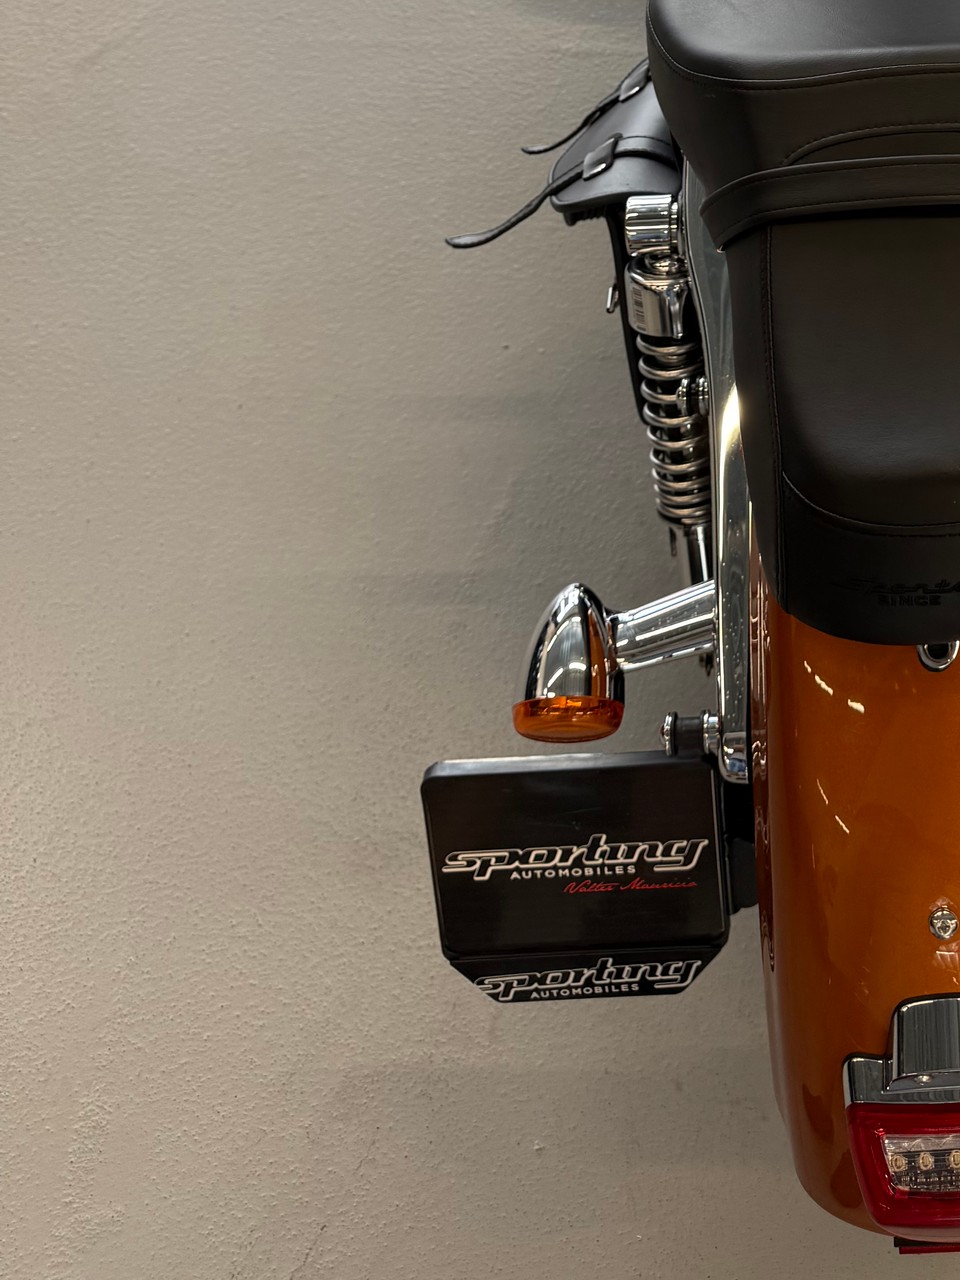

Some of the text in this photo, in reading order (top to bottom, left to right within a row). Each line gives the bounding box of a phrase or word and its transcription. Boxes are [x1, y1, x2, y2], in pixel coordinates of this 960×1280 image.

[876, 594, 943, 607] SINCE
[510, 864, 636, 881] AUTOMOBILES
[530, 983, 640, 1000] AUTOMOBILES
